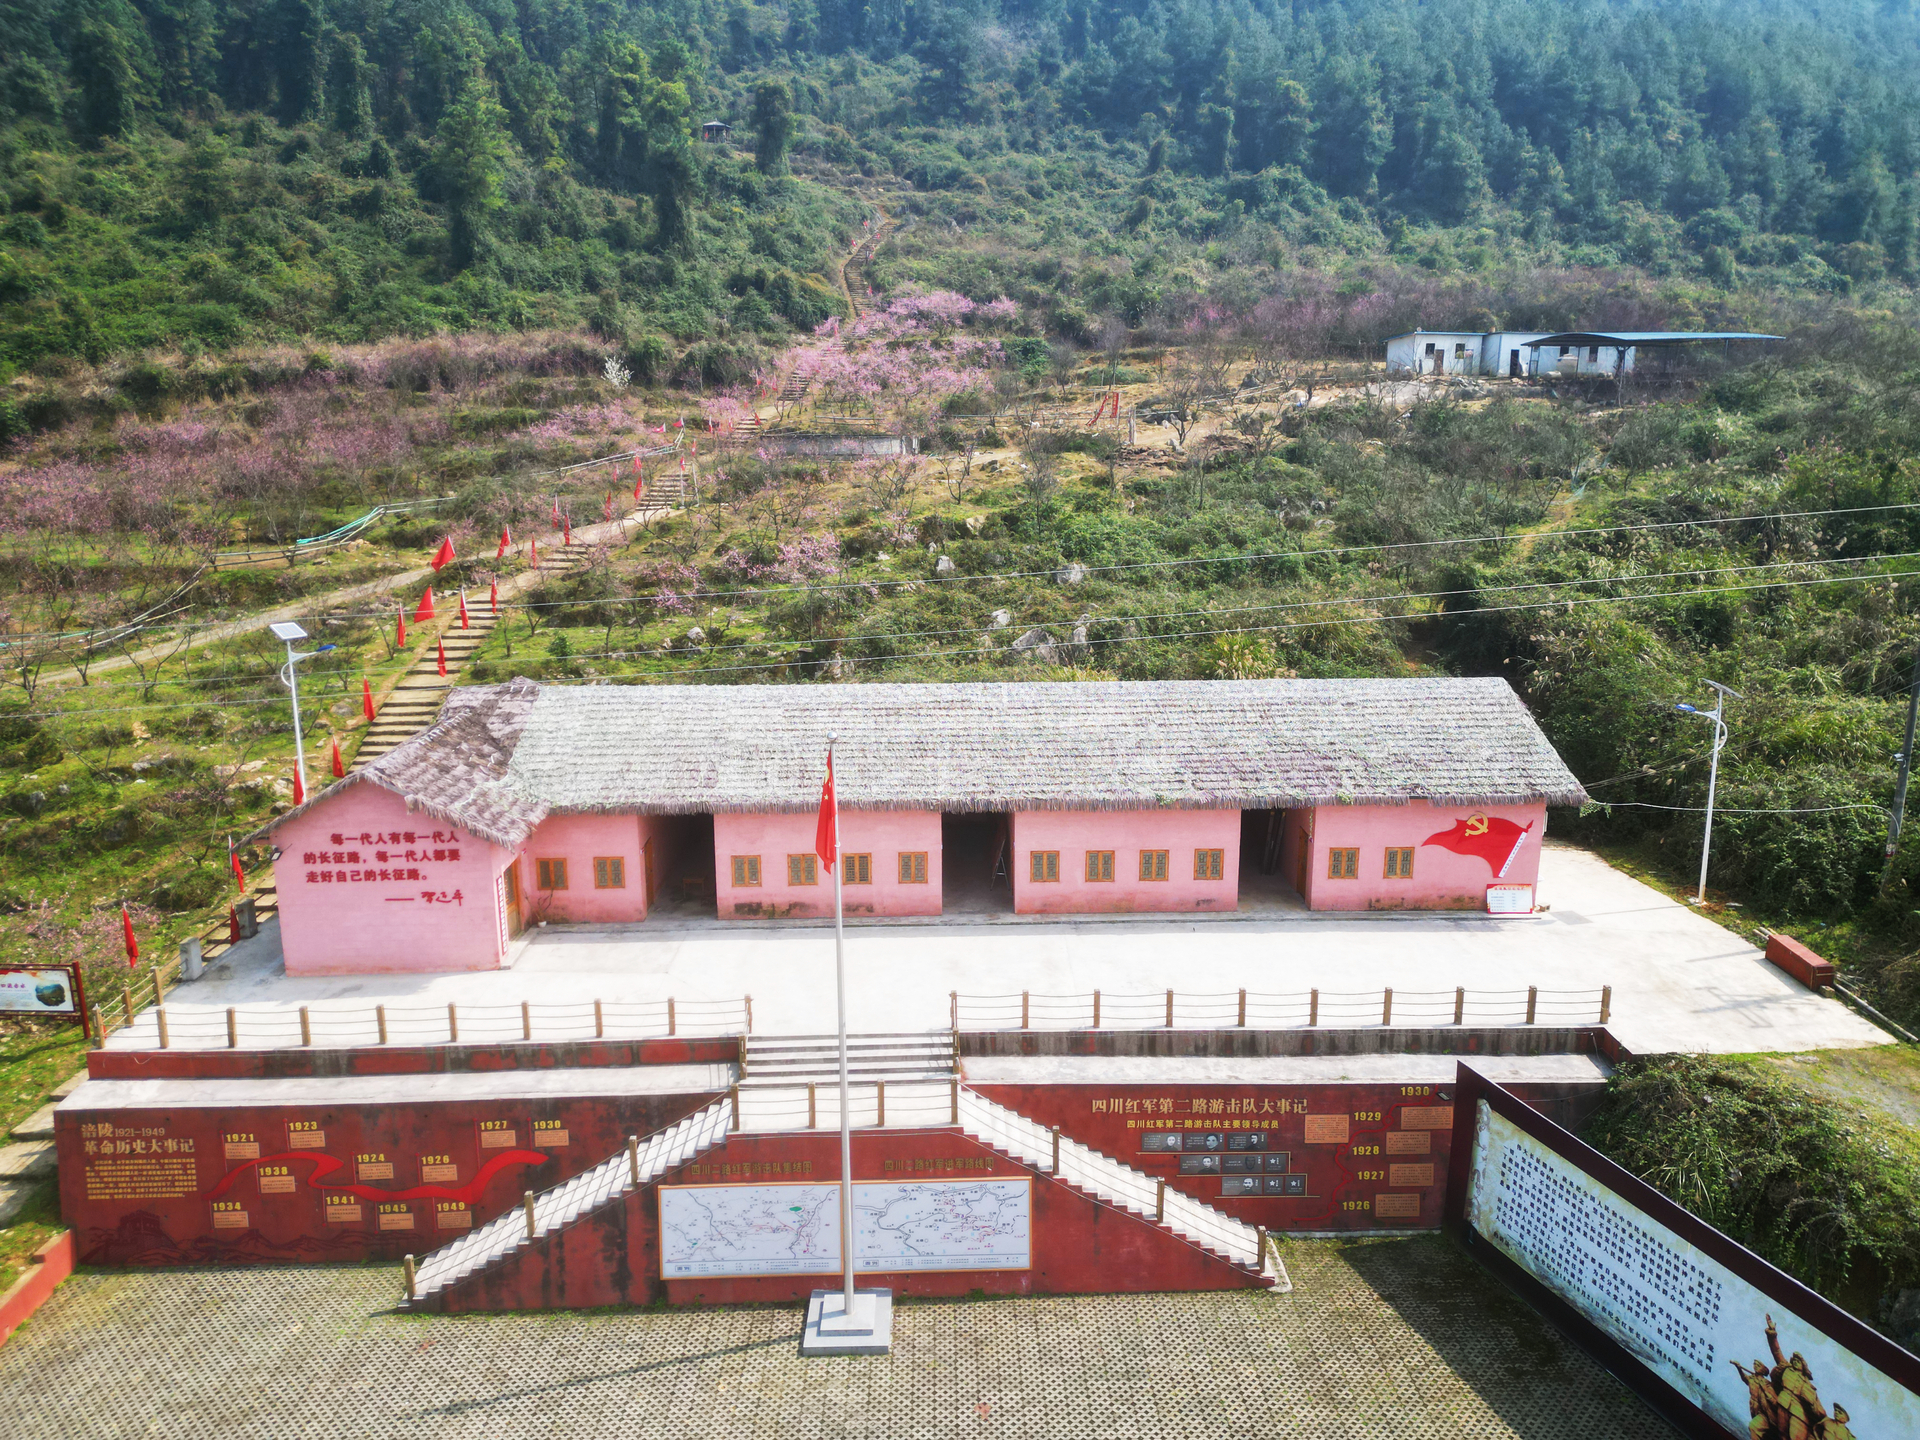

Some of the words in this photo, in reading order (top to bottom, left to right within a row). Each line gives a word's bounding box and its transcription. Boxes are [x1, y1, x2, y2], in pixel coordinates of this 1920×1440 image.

[330, 831, 460, 846] 每一代人有每一代人
[303, 849, 461, 864] 的长征路，每一代人都要
[306, 868, 429, 883] 走好自己的长征路。
[1401, 1086, 1430, 1096] 1930
[1091, 1098, 1308, 1114] 四川红军第二路游击队大事记
[1354, 1111, 1382, 1121] 1929
[288, 1121, 318, 1131] 1923
[480, 1120, 508, 1130] 1927
[533, 1120, 562, 1129] 1930
[1127, 1119, 1279, 1129] 四川红军第二路游击队主要领导成员
[226, 1133, 254, 1142] 1921
[83, 1138, 195, 1155] 革命历史大事记
[1352, 1145, 1380, 1155] 1928
[357, 1153, 386, 1163] 1924
[421, 1155, 450, 1164] 1926
[691, 1161, 813, 1175] 四川二路红军游击队集结图
[884, 1157, 995, 1171] 四川二路红军进军路线图
[259, 1166, 288, 1176] 1938
[1357, 1171, 1385, 1180] 1927
[326, 1195, 355, 1205] 1941
[212, 1202, 242, 1211] 1934
[379, 1203, 407, 1213] 1945
[437, 1201, 466, 1211] 1949
[1342, 1201, 1370, 1211] 1926
